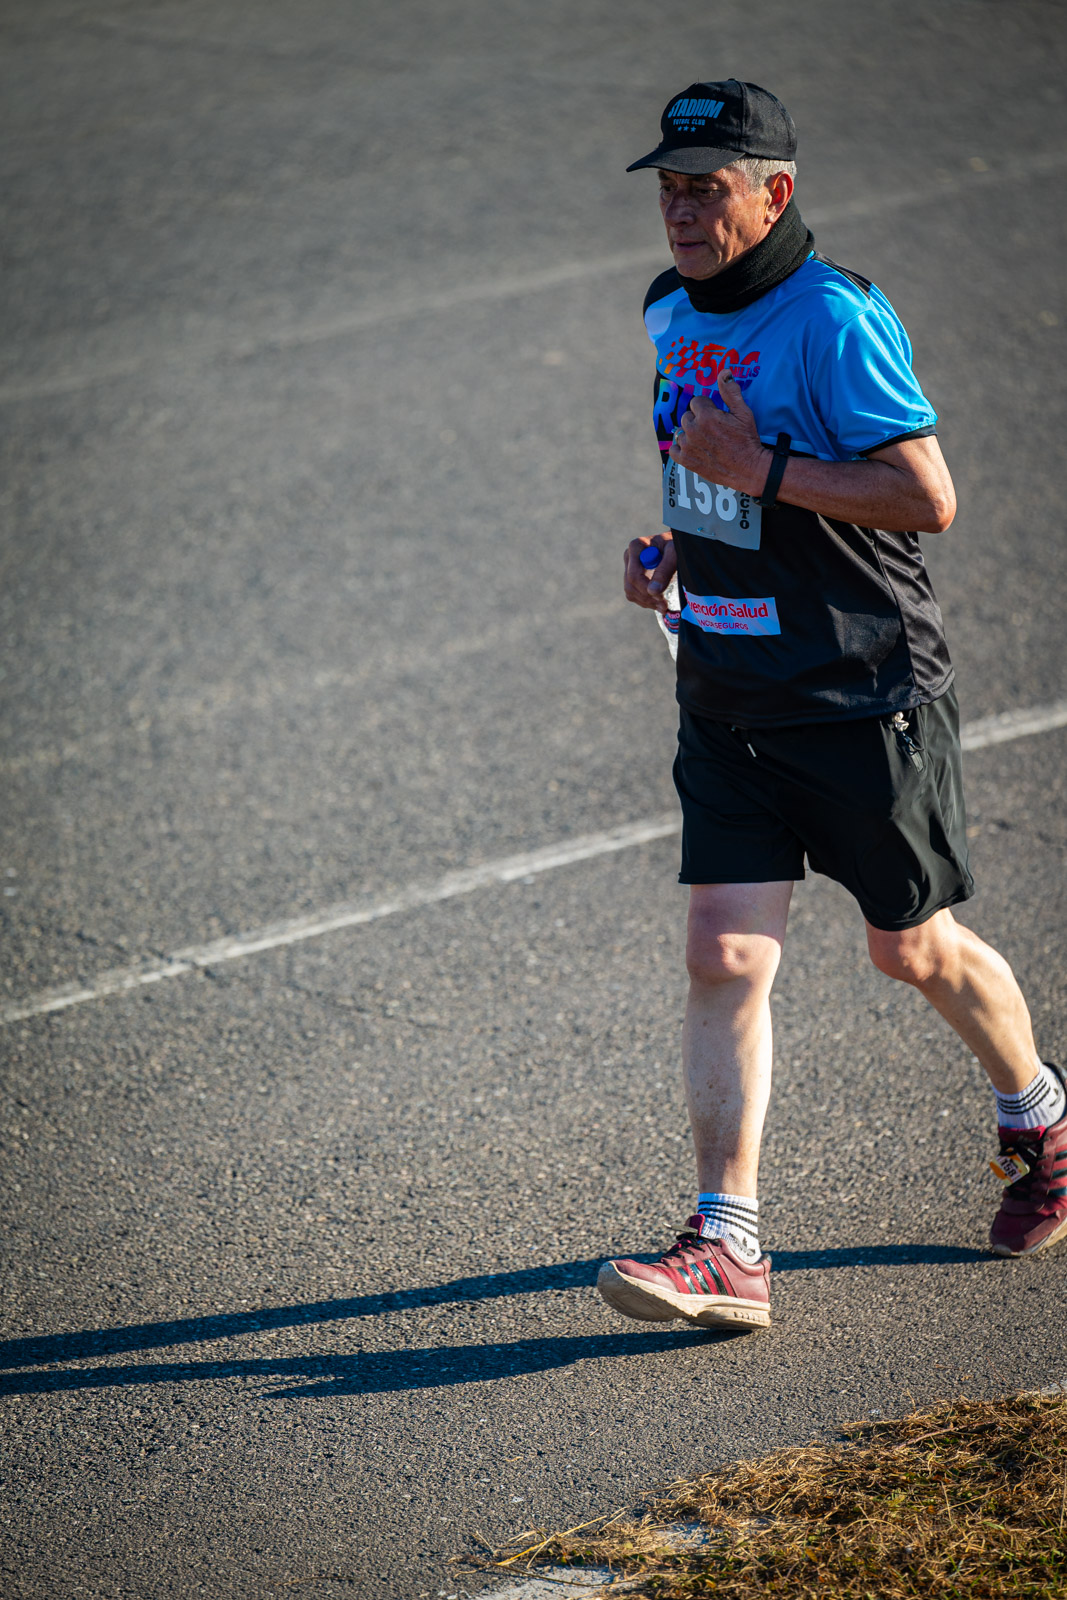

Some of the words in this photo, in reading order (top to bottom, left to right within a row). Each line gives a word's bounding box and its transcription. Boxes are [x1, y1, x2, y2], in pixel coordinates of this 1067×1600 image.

[667, 98, 725, 118] STADIUM
[677, 464, 738, 522] 158
[740, 492, 750, 530] ACTO
